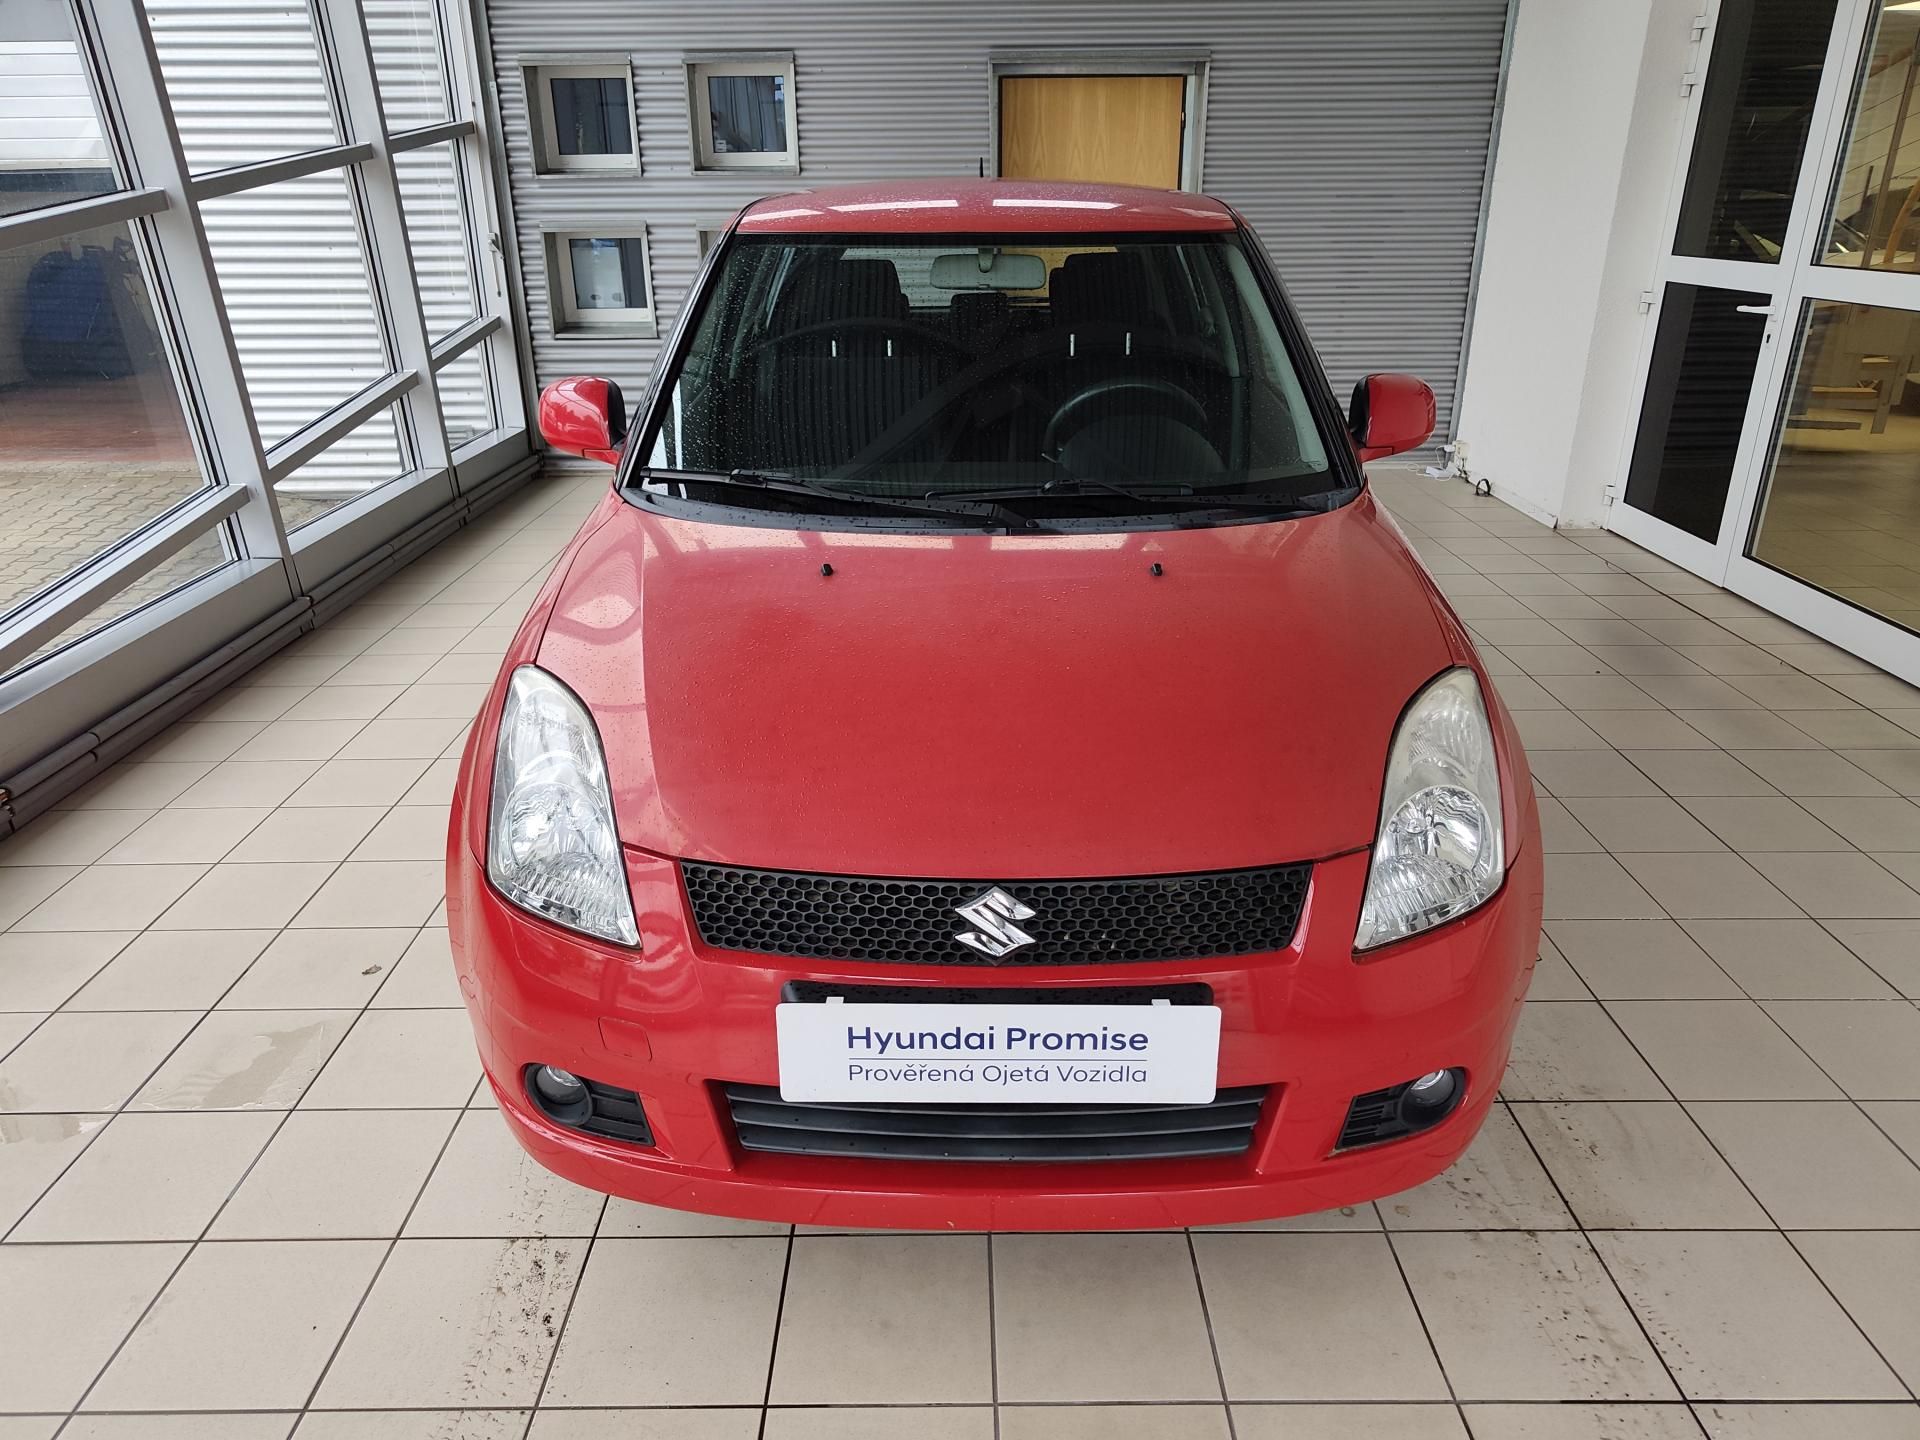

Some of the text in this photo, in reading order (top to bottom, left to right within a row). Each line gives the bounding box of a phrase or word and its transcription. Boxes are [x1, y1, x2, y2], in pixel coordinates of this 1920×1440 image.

[847, 1025, 1149, 1055] Hyundai Promise
[848, 1063, 1147, 1086] Prověřená Ojetá Vozidla
